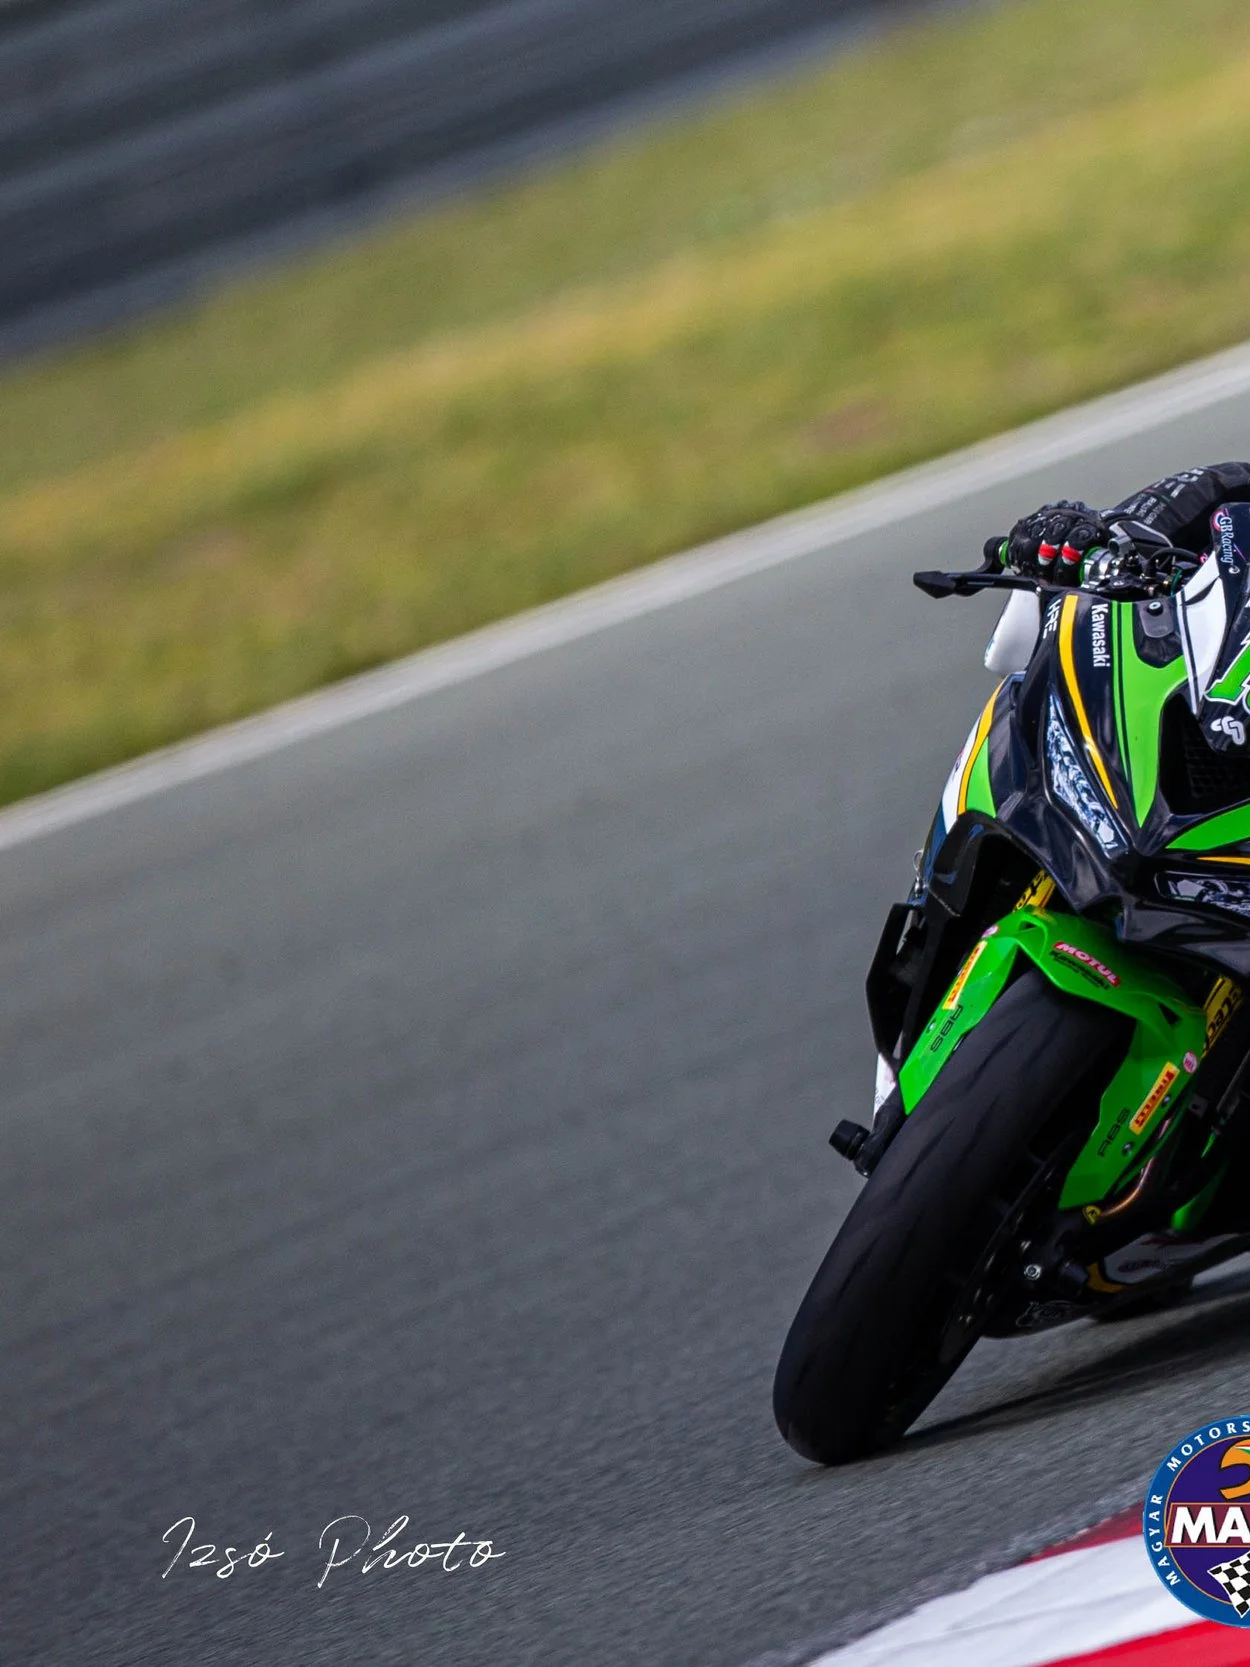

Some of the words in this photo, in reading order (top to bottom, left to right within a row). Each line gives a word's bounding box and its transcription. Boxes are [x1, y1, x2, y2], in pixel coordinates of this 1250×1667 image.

[1219, 516, 1234, 565] GBRacing
[1091, 603, 1111, 667] Kawasaki
[1055, 942, 1119, 985] MOTUL
[930, 1004, 963, 1053] ABS
[1134, 1070, 1175, 1128] PIRELLI
[1097, 1106, 1131, 1157] ABS
